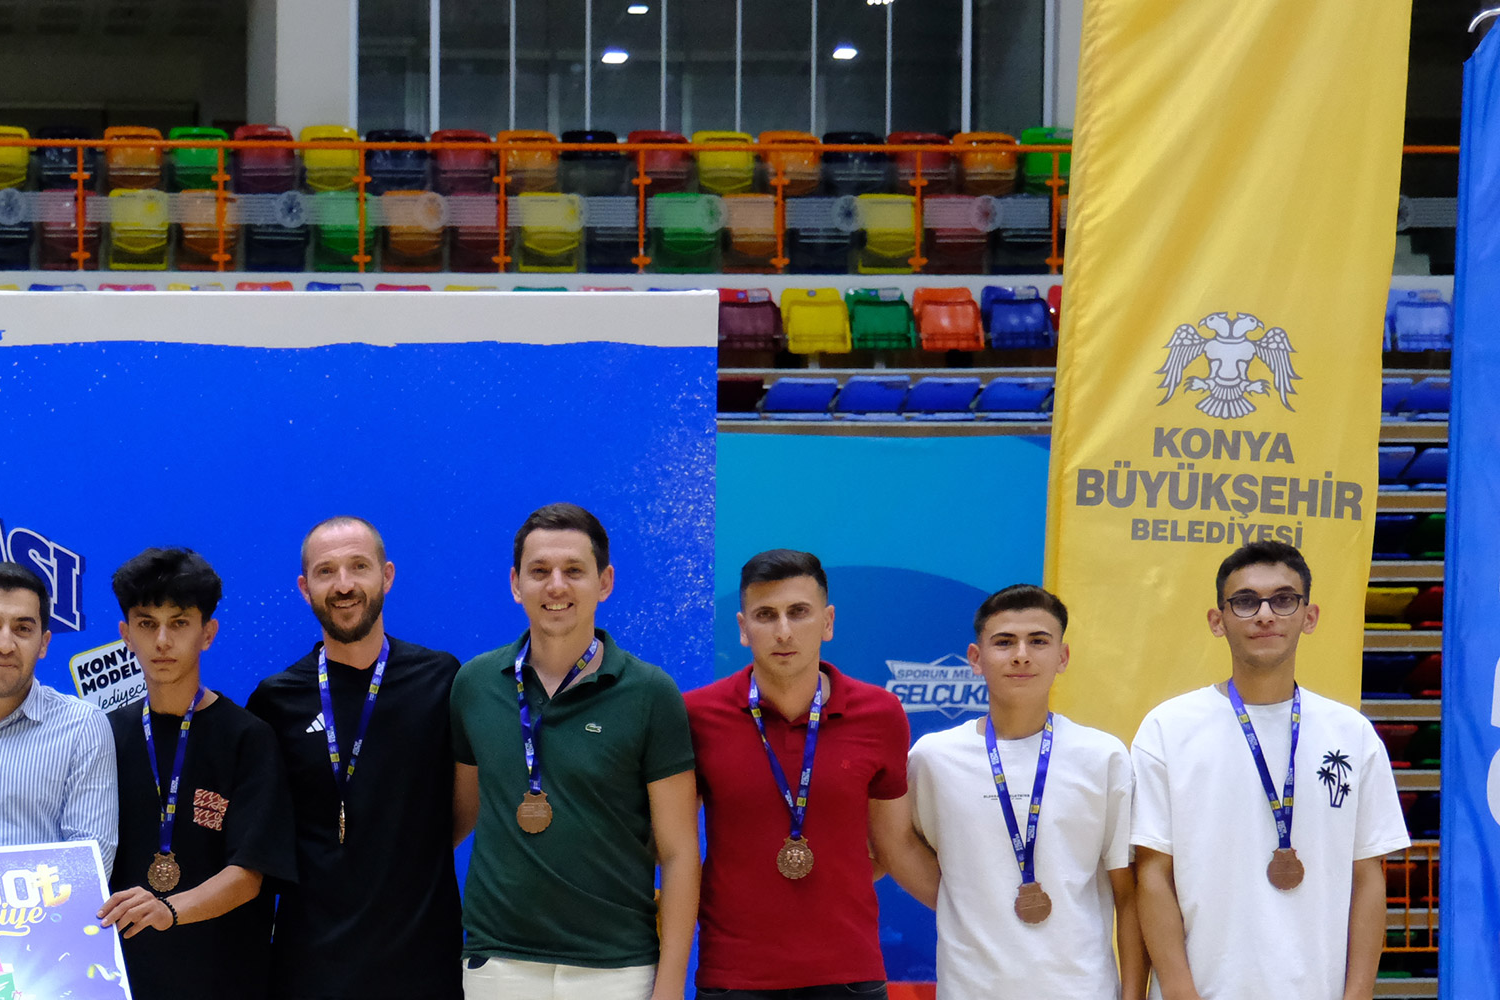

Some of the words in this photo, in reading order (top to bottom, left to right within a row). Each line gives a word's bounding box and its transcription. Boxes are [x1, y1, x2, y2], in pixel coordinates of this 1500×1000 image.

[1152, 427, 1295, 463] KONYA
[1076, 460, 1363, 521] BÜYÜKŞEHİR
[77, 646, 136, 680] KONY
